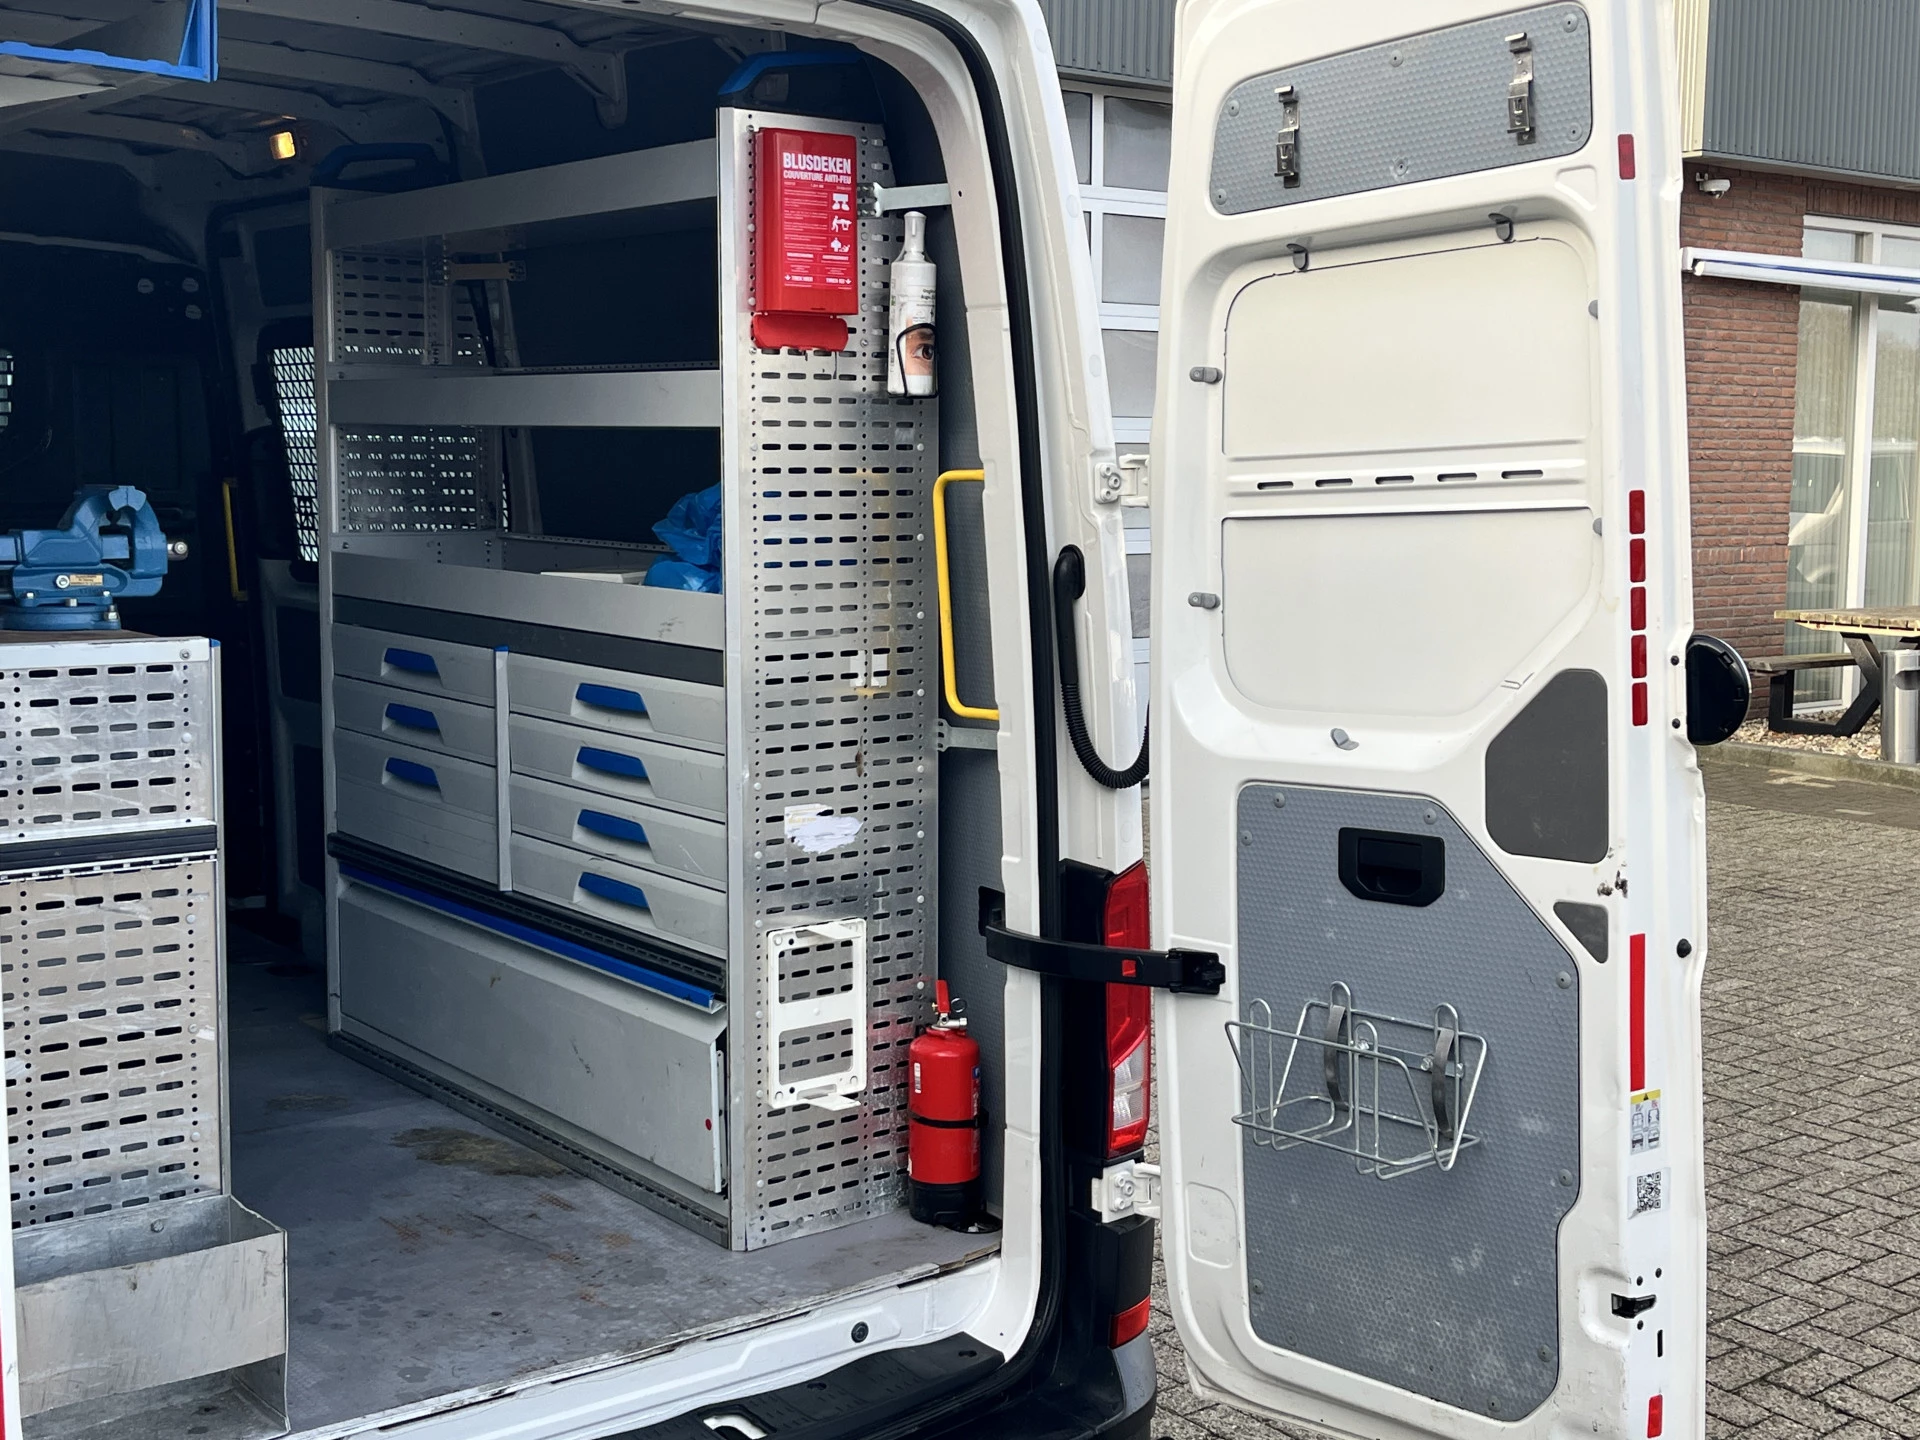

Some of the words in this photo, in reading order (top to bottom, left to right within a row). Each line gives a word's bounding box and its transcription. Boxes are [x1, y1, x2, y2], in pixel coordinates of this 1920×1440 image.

[783, 152, 851, 174] BLUSDEKEN
[783, 170, 823, 181] COUVERTURE
[824, 174, 851, 184] ANTI-FEU
